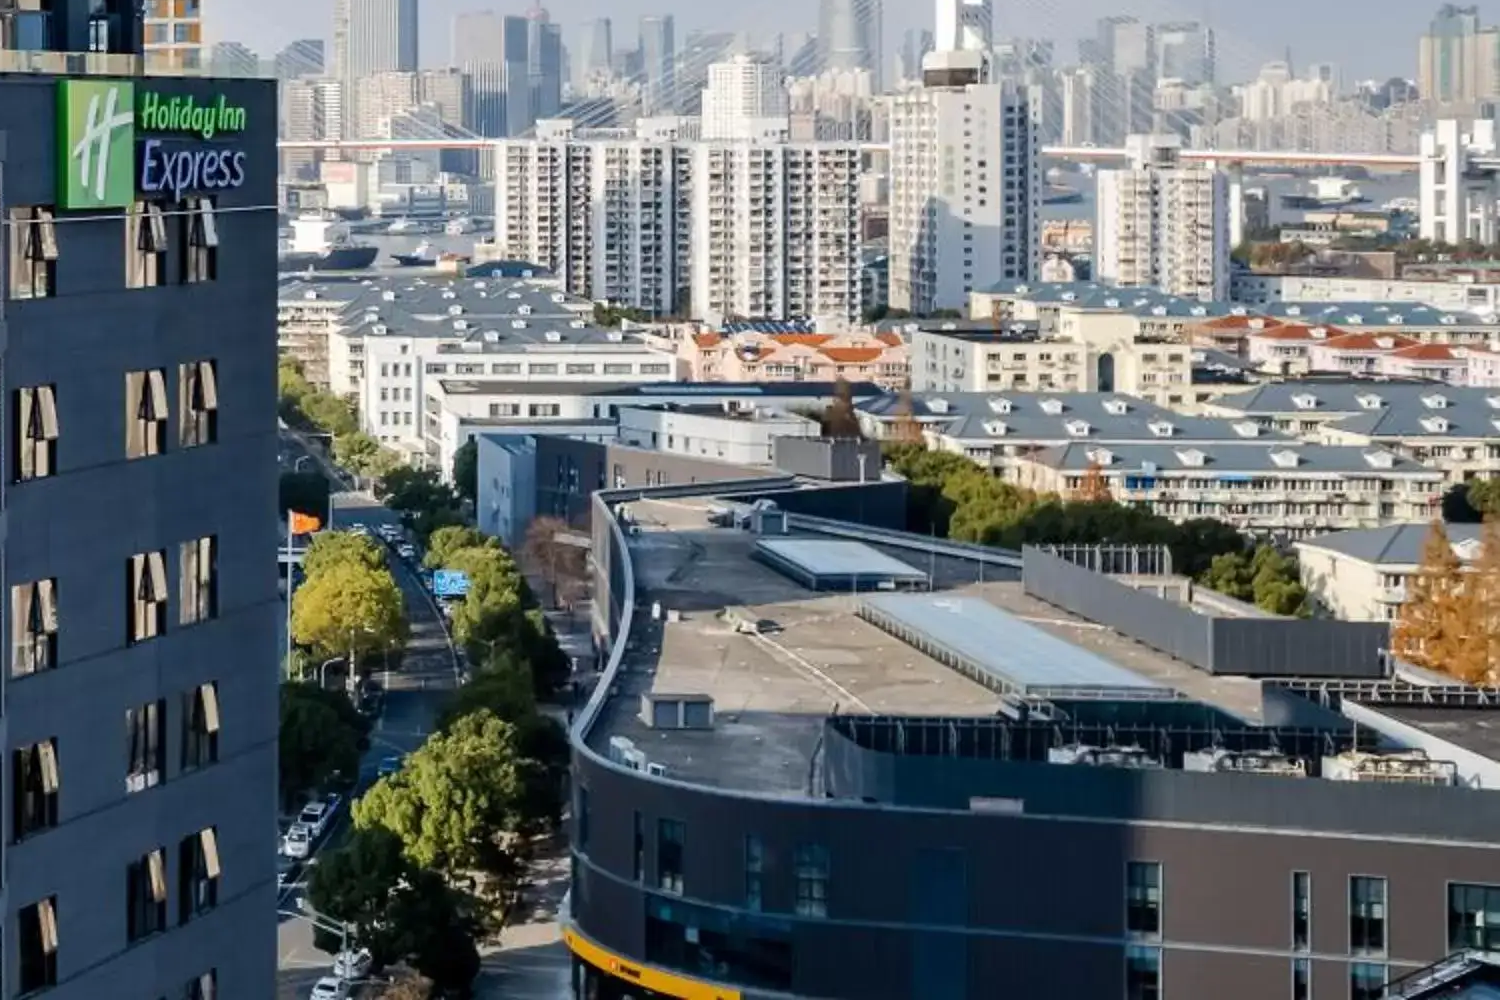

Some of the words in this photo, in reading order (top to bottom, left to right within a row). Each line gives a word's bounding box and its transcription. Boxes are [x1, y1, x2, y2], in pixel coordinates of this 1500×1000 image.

[142, 92, 217, 139] Holiday
[218, 94, 246, 131] Inn
[141, 139, 246, 203] Express
